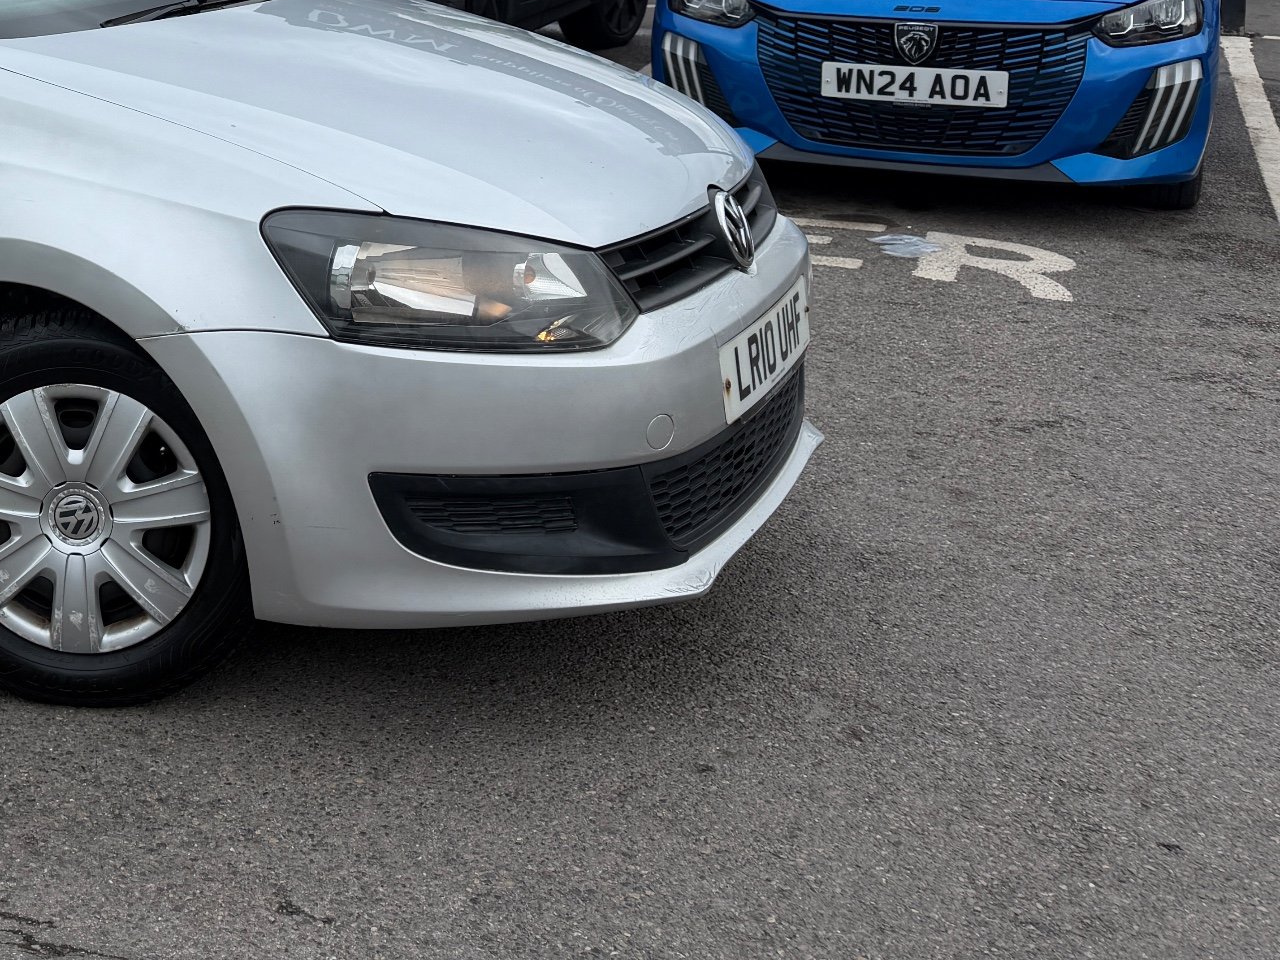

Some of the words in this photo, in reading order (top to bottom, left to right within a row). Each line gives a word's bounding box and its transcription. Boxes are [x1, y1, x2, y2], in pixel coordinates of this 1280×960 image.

[893, 5, 941, 13] 208
[836, 67, 918, 98] WN24
[929, 73, 991, 102] AOA
[734, 318, 777, 402] LR10
[776, 292, 801, 363] UHF
